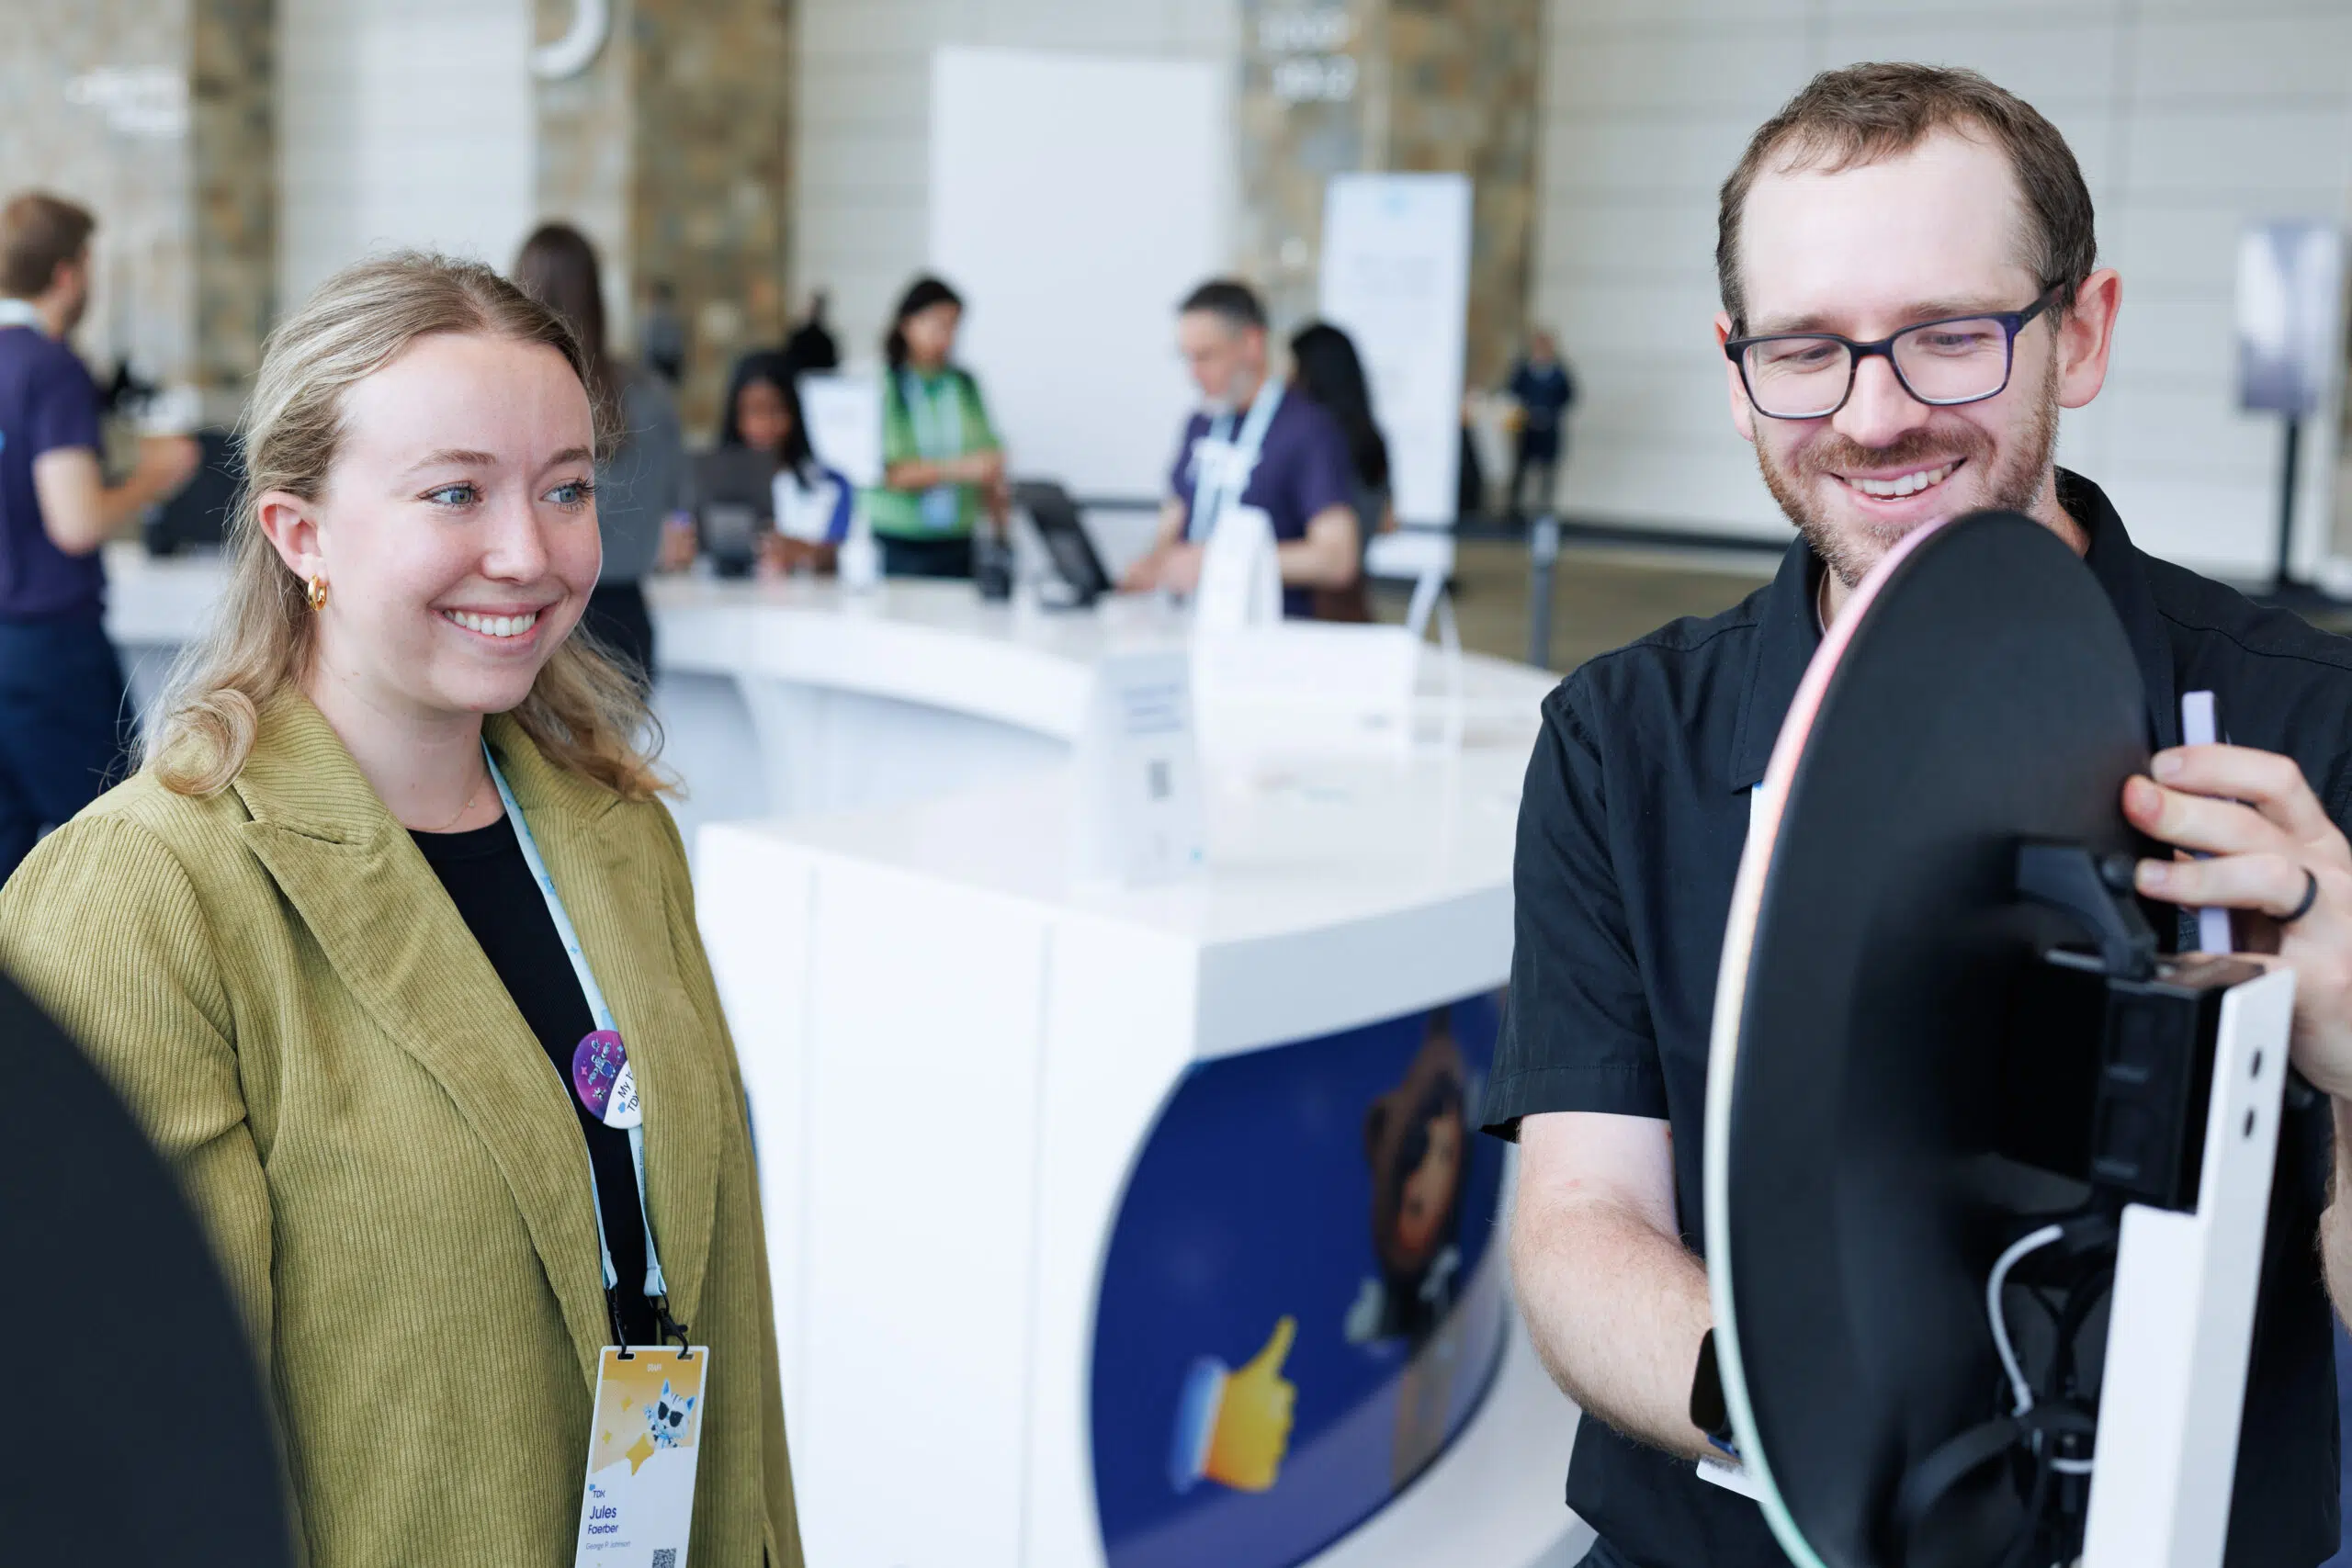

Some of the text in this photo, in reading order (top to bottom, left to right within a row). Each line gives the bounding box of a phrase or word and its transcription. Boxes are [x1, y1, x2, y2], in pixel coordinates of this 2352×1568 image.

[617, 1081, 631, 1099] My
[593, 1490, 605, 1498] TDX
[589, 1505, 617, 1520] Jules
[587, 1523, 618, 1535] Faerber
